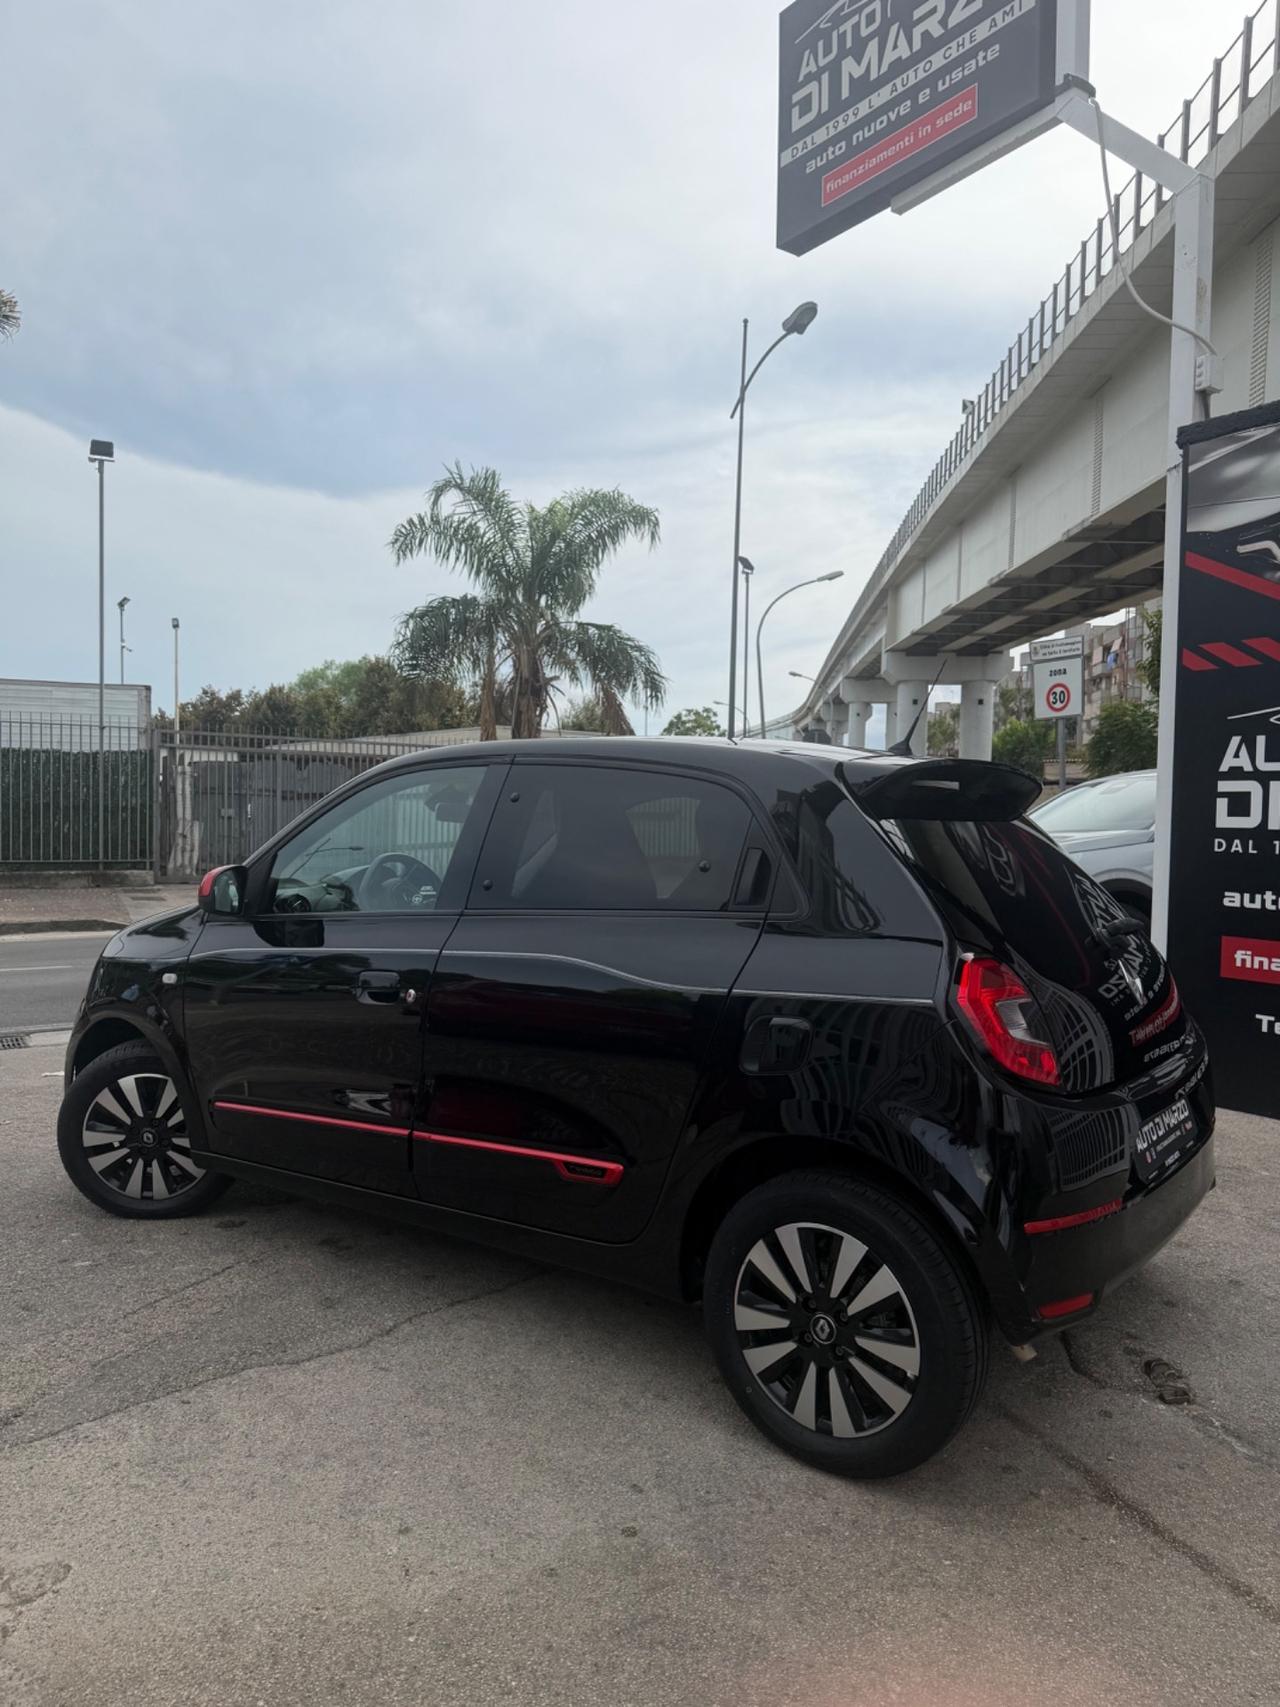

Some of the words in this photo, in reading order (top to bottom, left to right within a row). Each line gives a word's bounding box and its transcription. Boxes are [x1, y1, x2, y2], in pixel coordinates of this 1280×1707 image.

[798, 0, 881, 82] AUTO
[791, 135, 817, 159] DAL
[825, 106, 860, 137] 1999
[889, 60, 933, 97] AUTO
[943, 29, 977, 60] CHE
[988, 0, 1023, 32] AMI
[791, 71, 829, 133] DI
[806, 140, 846, 174] auto
[852, 99, 911, 146] nuove
[918, 88, 930, 104] e
[937, 44, 1000, 93] usate
[826, 132, 914, 193] finanziamenti
[918, 125, 932, 139] in
[935, 99, 972, 128] sede
[1051, 690, 1066, 705] 30
[1214, 838, 1258, 854] DAL
[1223, 890, 1280, 910] aut
[1136, 1121, 1157, 1153] AUTO
[1155, 1114, 1165, 1137] DI
[1162, 1099, 1189, 1131] MARZO
